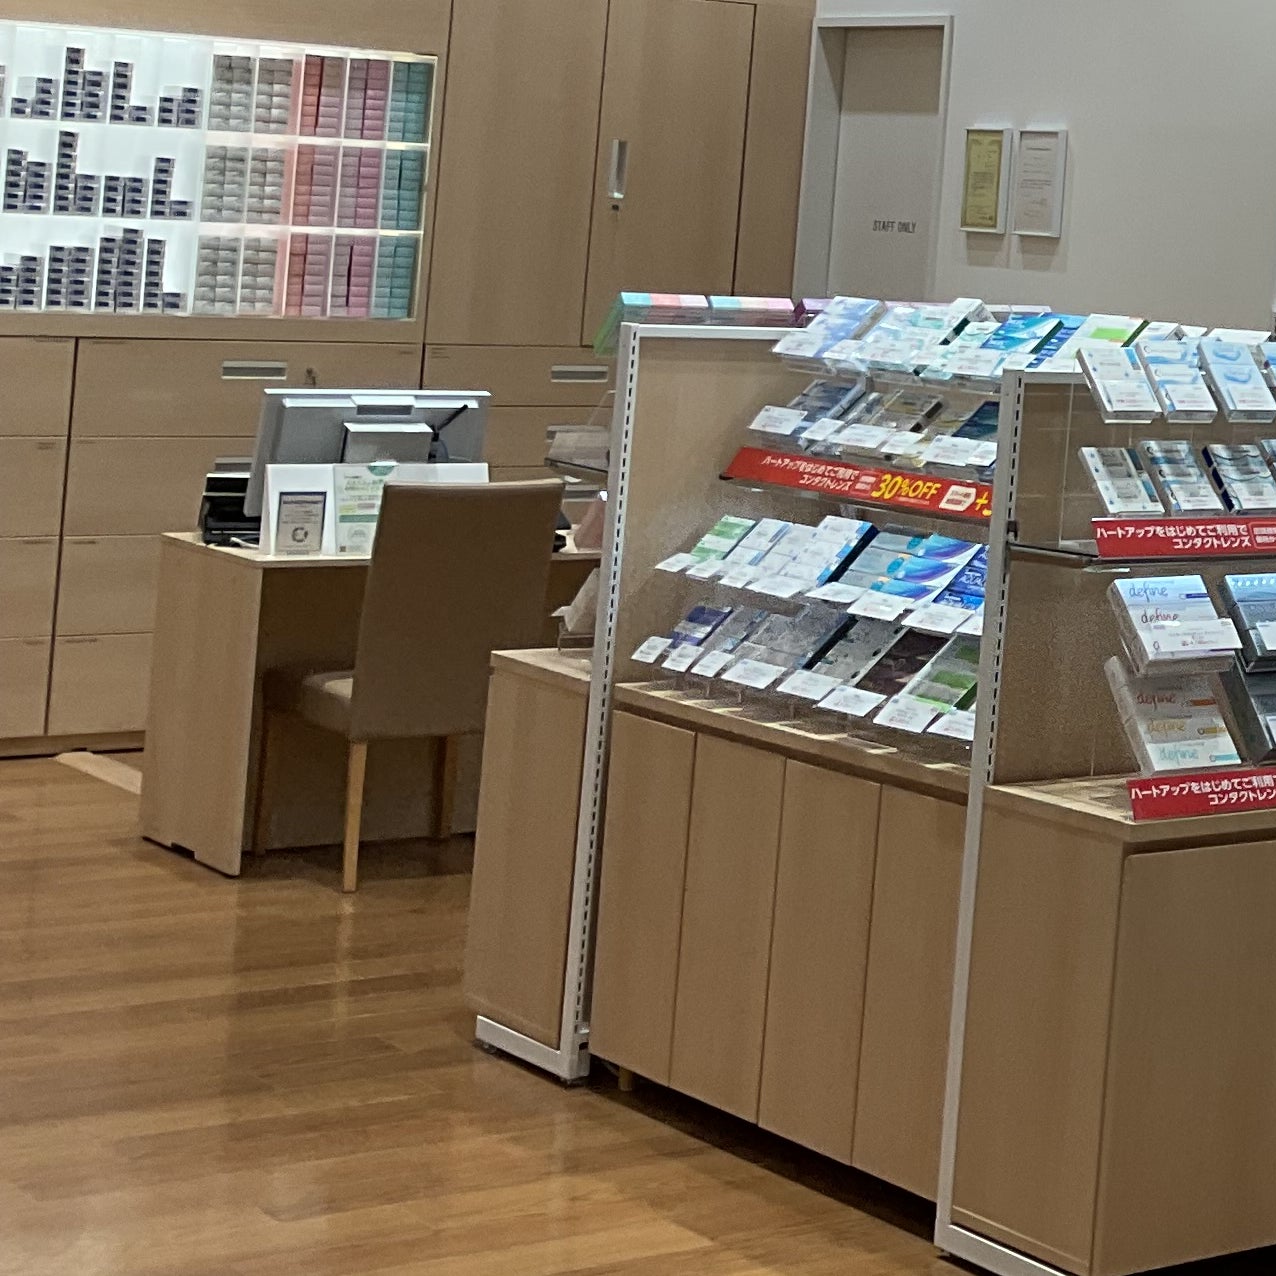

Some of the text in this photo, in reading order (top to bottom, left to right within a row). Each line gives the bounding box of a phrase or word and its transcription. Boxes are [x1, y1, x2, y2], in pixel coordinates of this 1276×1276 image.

[872, 219, 917, 233] STAFF ONLY
[871, 473, 943, 500] 30%OFF
[1096, 524, 1249, 539] ハートアップをはじめてご利用で
[1172, 536, 1252, 549] コンタクトレンズ
[1129, 584, 1169, 602] define
